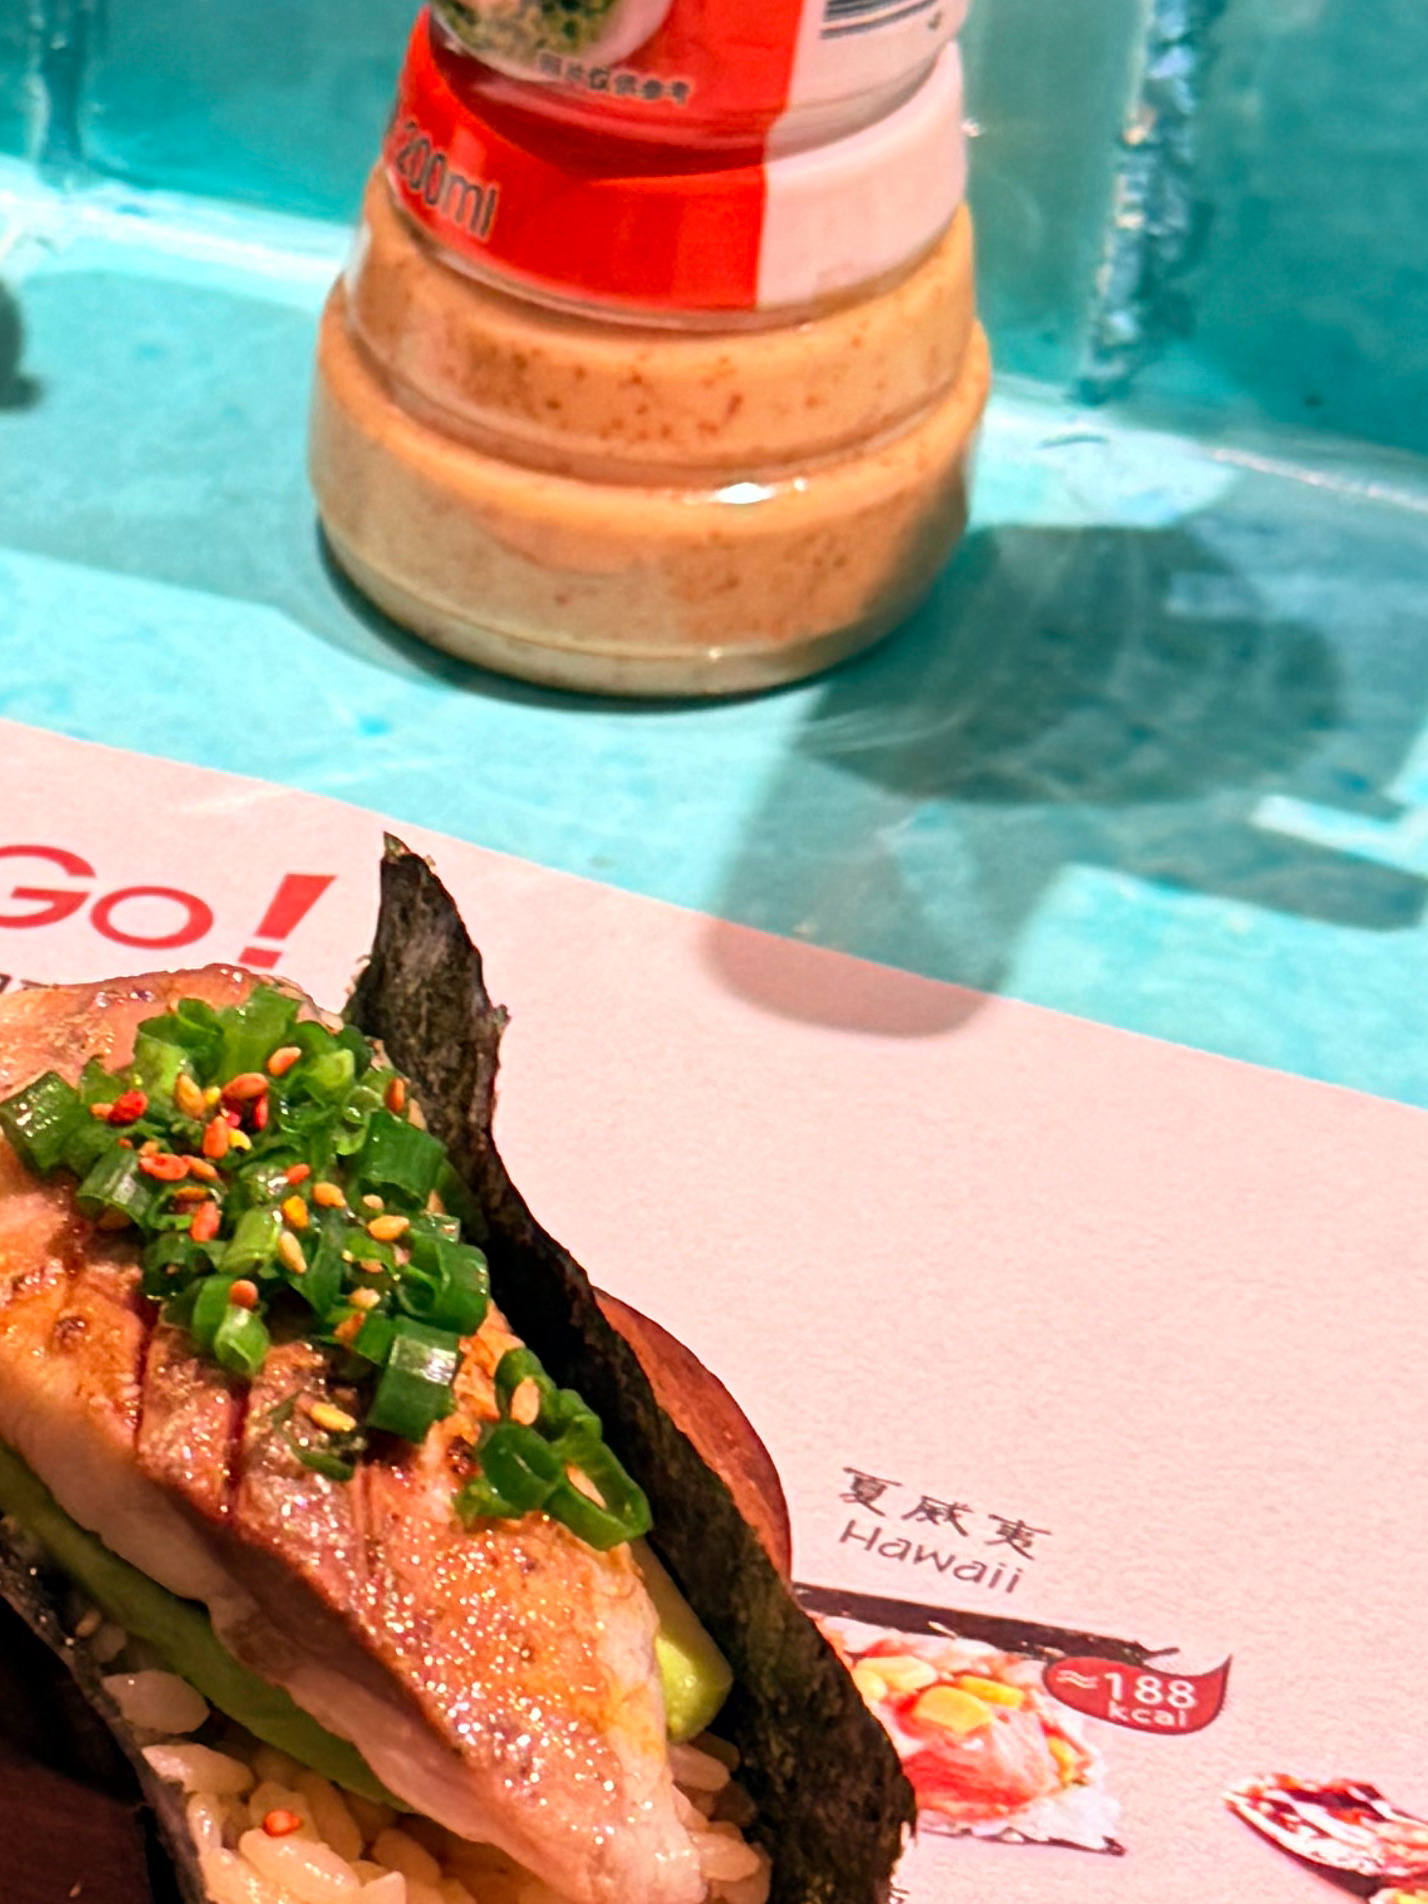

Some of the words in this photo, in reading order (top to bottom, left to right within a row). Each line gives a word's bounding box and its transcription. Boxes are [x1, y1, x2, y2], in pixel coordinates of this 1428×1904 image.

[837, 1466, 1053, 1562] 夏威夷
[837, 1518, 1025, 1596] Hawaii
[1108, 1698, 1188, 1728] kcal
